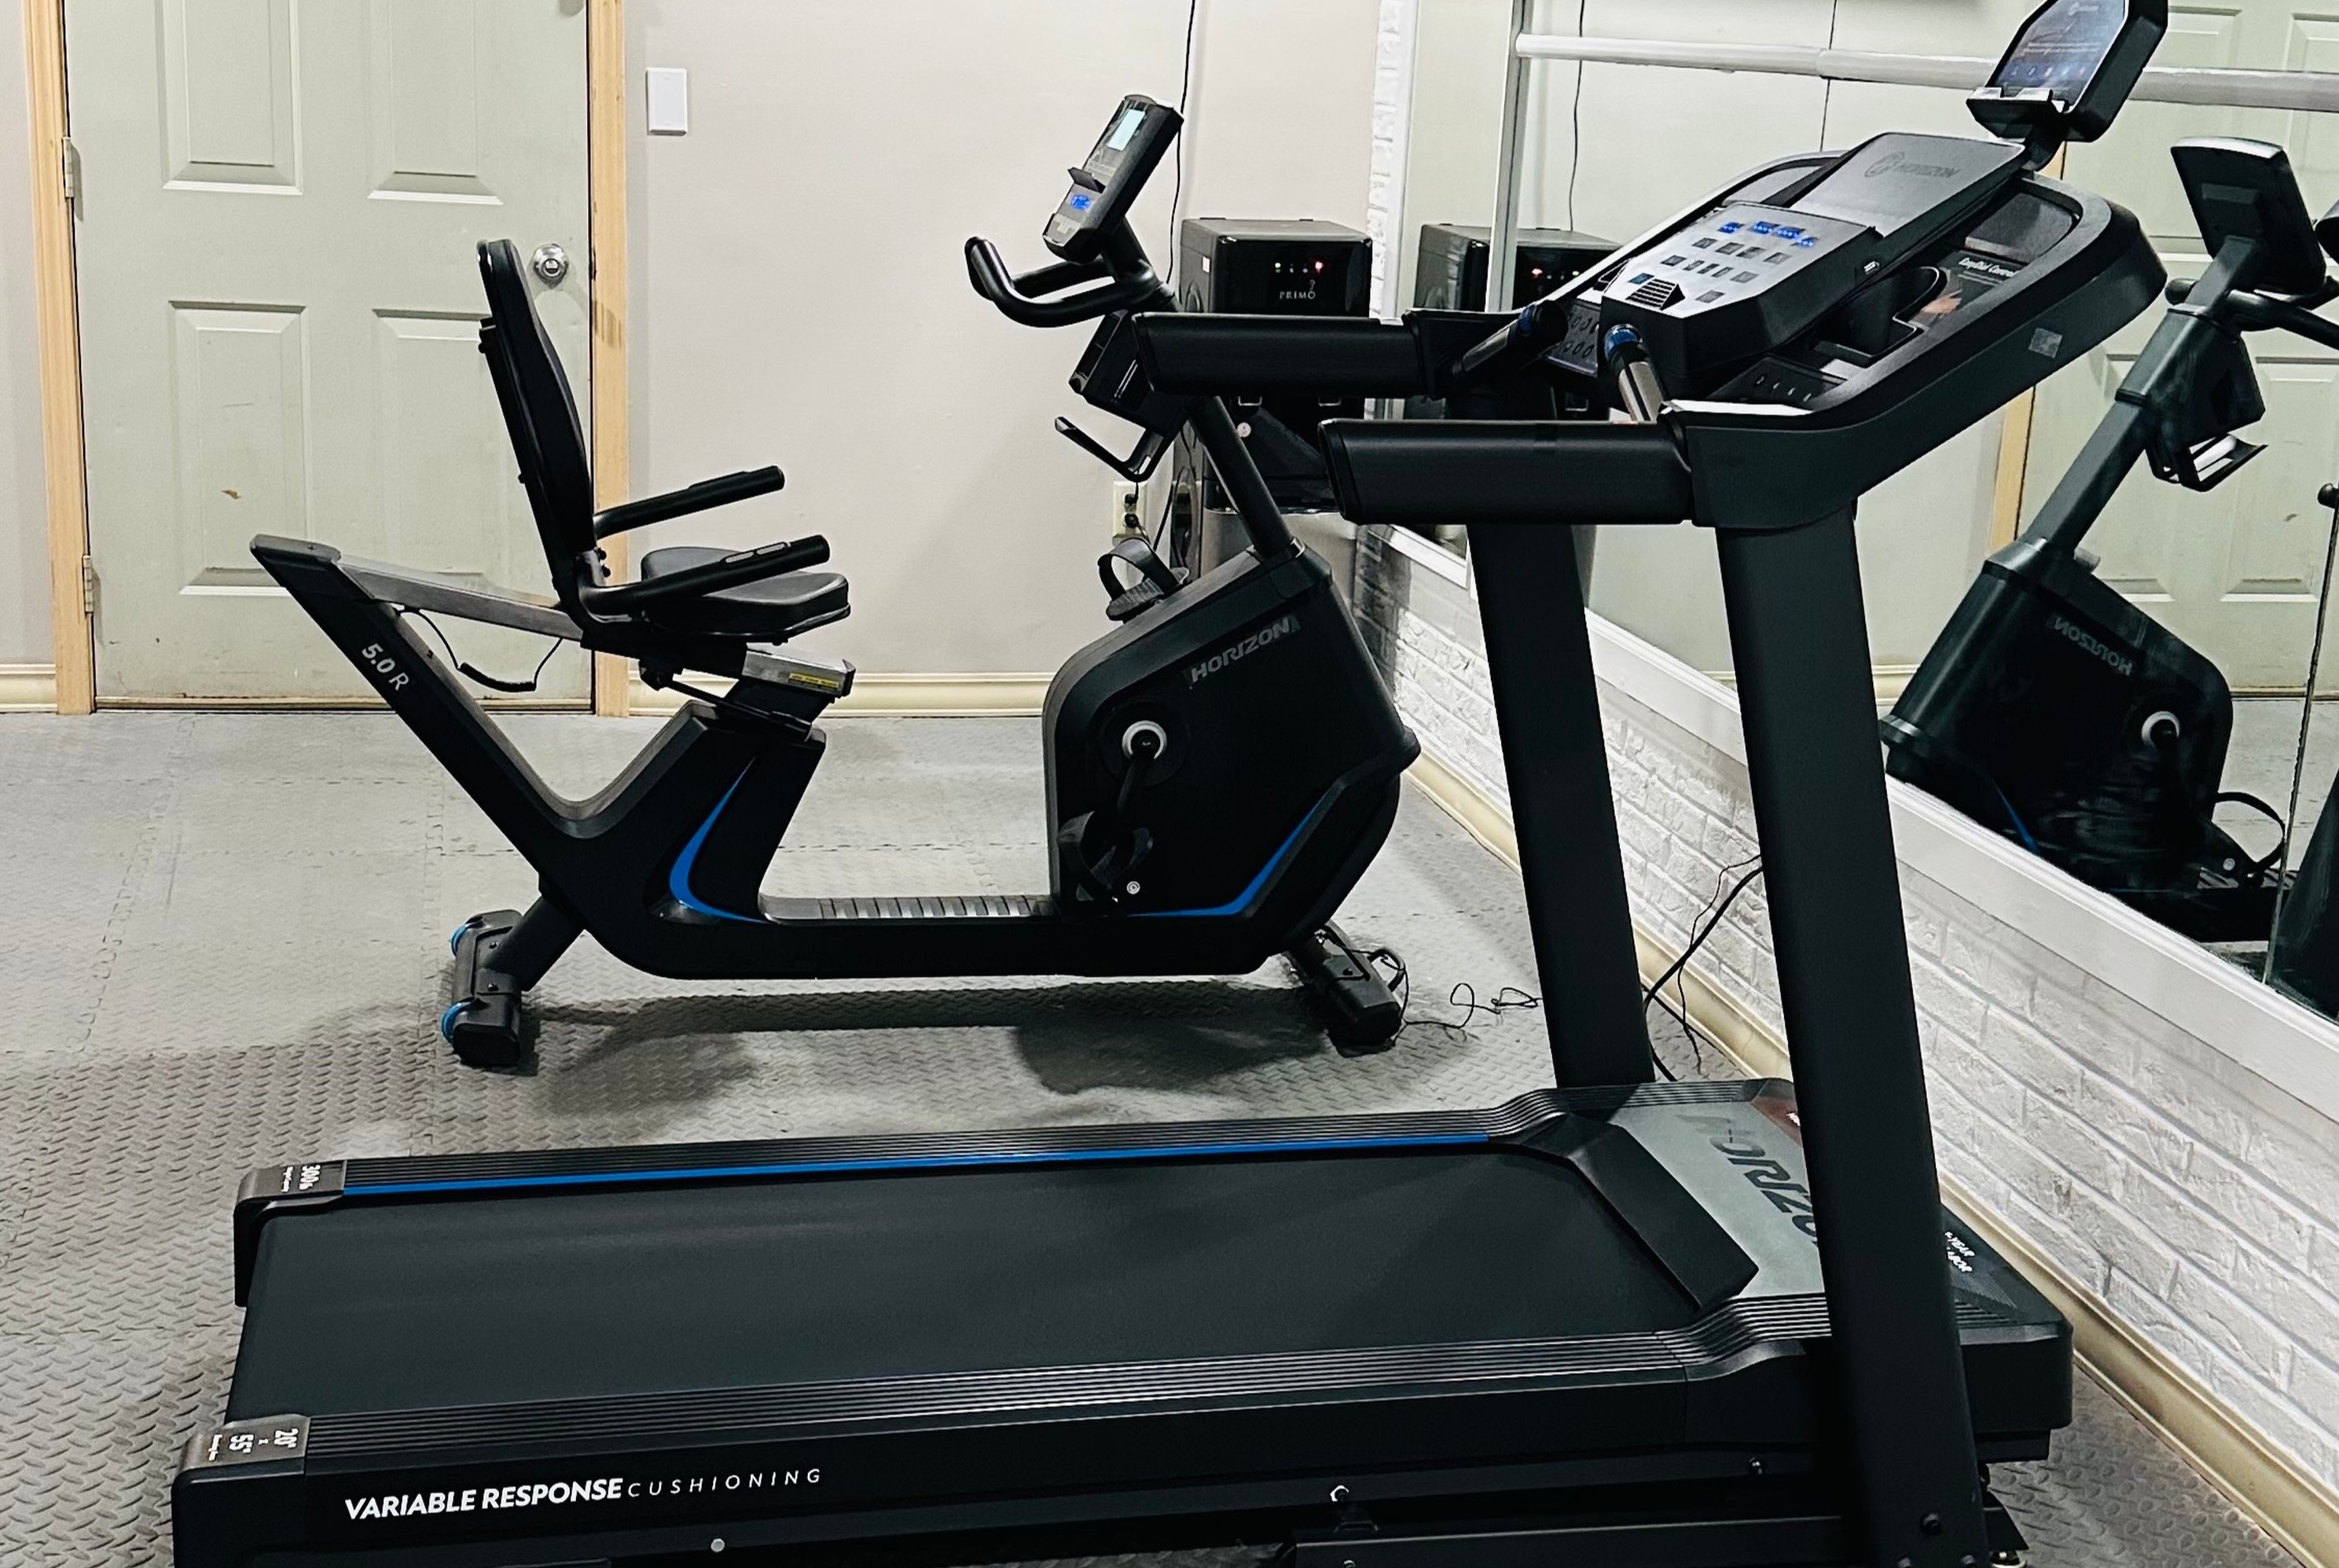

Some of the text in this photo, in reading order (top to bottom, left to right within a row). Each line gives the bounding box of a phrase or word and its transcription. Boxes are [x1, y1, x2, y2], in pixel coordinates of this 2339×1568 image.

[1279, 291, 1316, 299] PRIMO
[362, 643, 409, 691] 5.0 R
[1191, 617, 1291, 683] HORIZON
[345, 1468, 821, 1519] VARIABLE RESPONSE CUSHIONING
